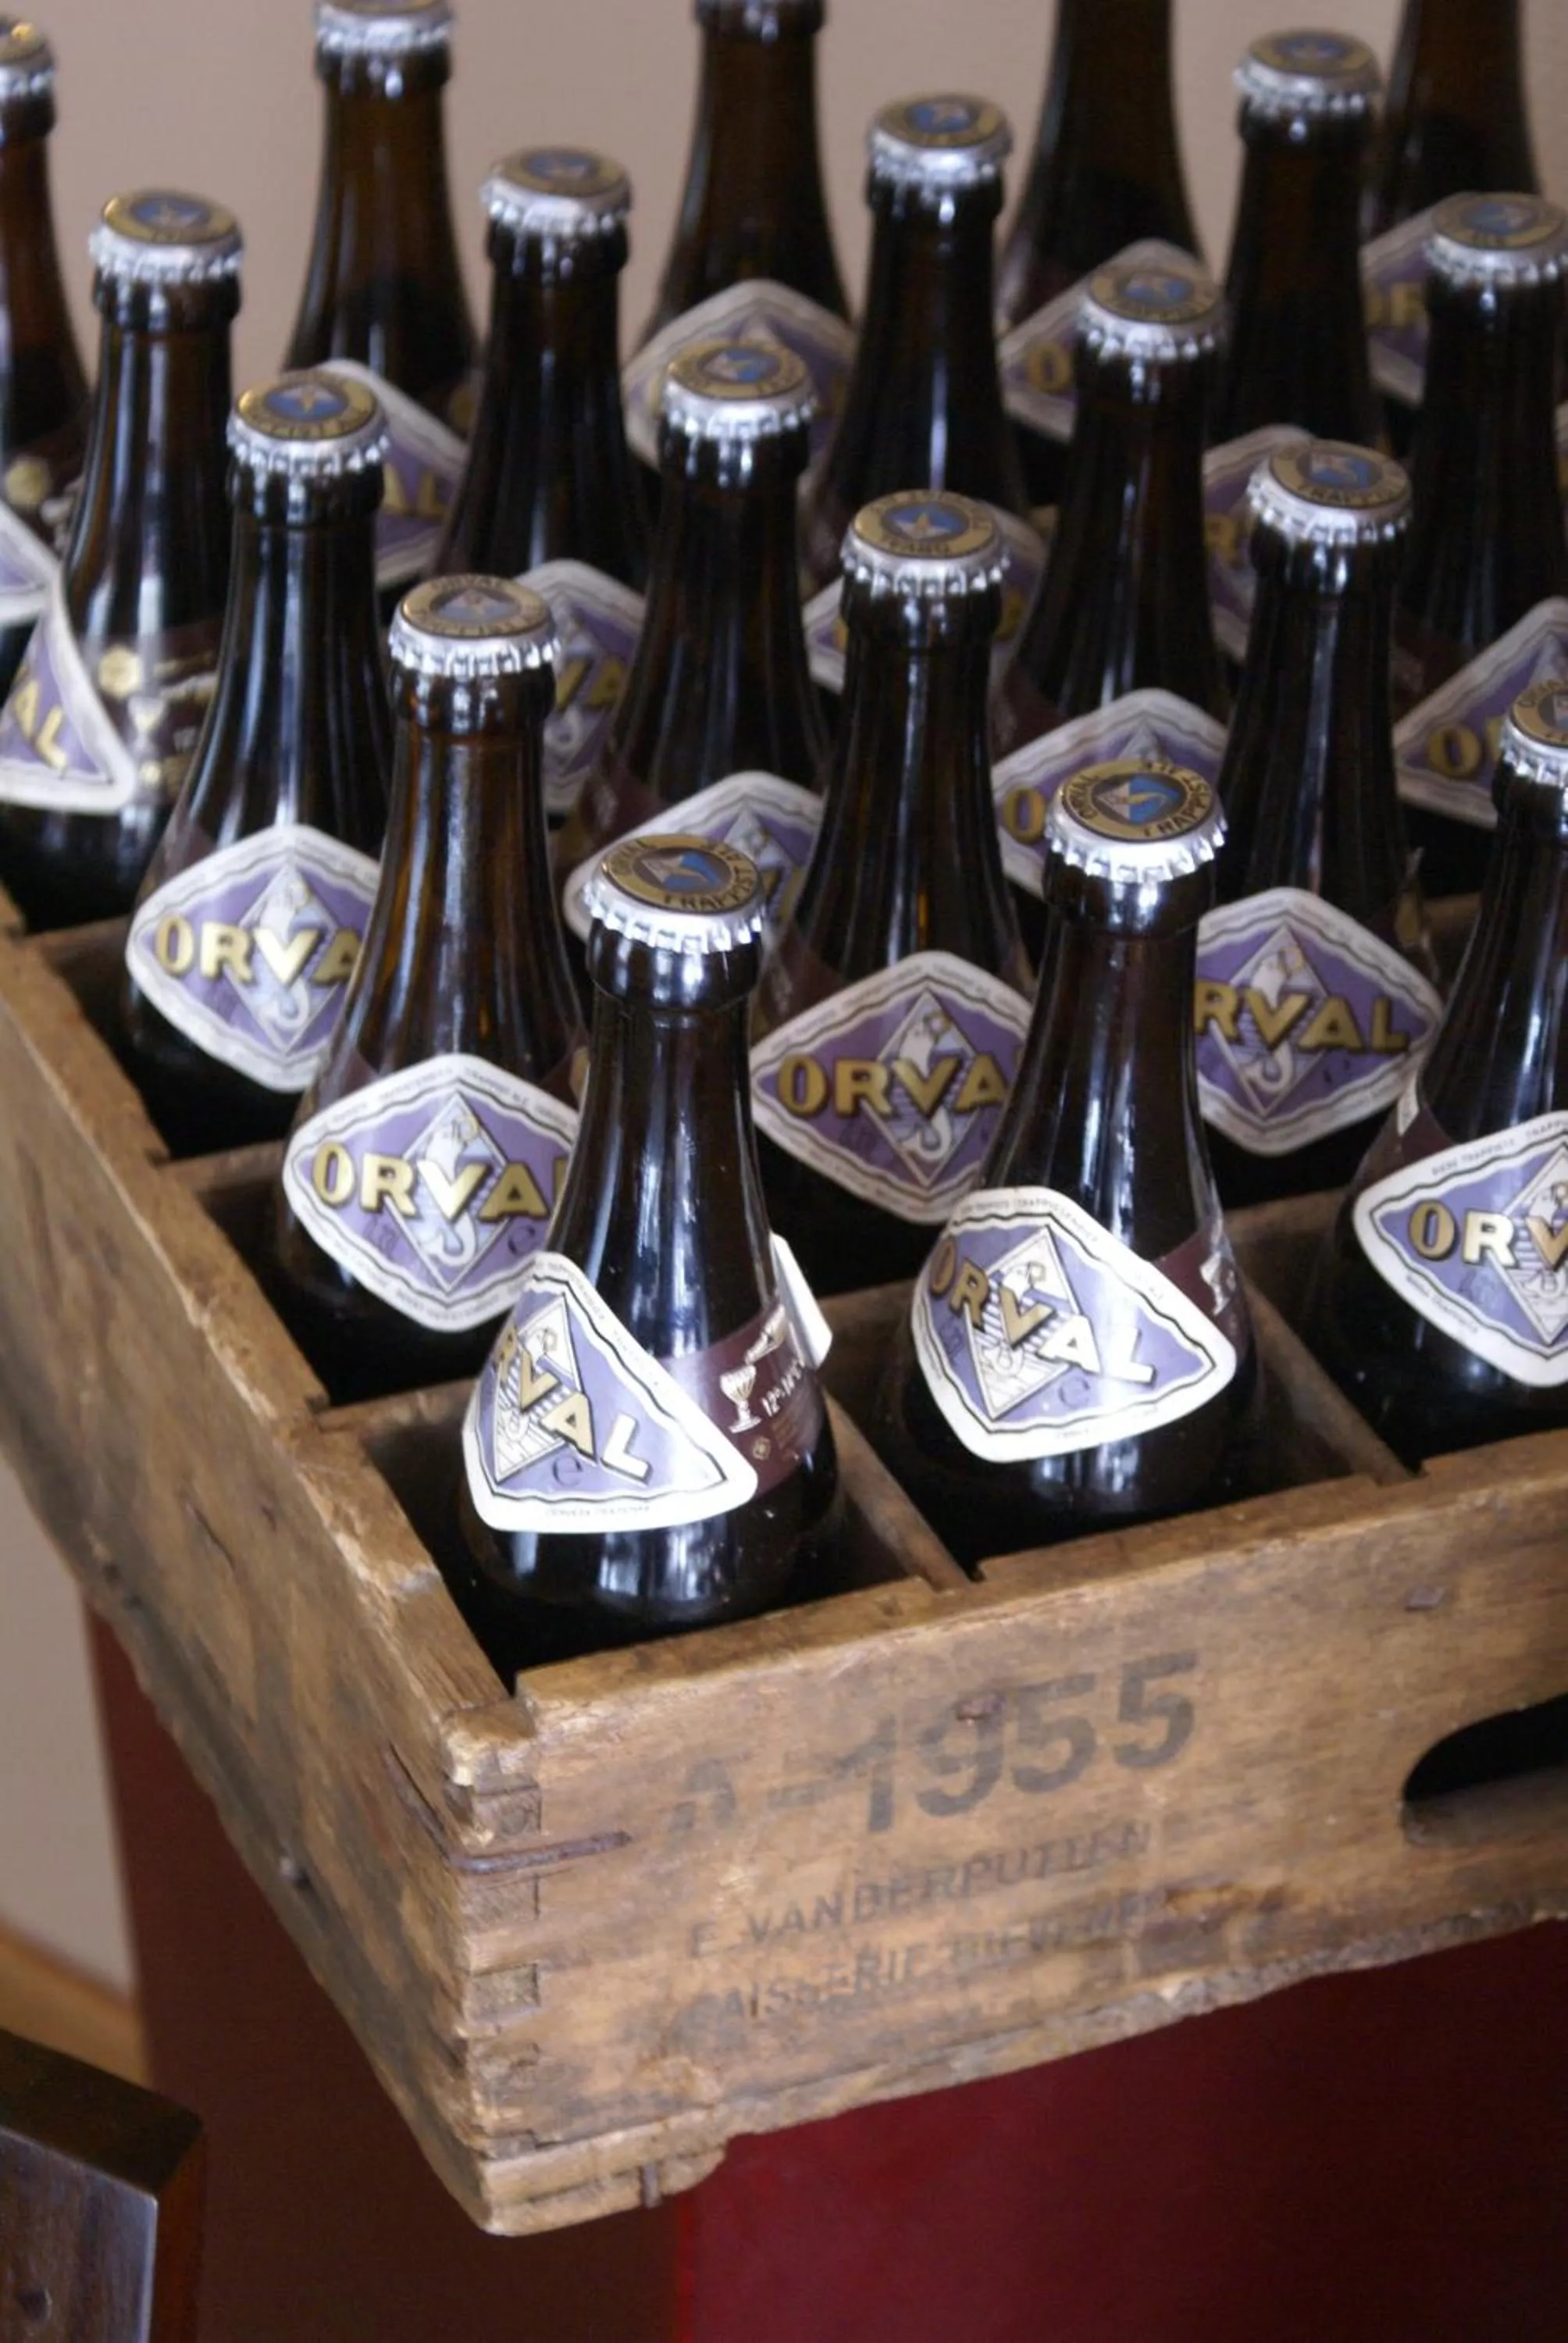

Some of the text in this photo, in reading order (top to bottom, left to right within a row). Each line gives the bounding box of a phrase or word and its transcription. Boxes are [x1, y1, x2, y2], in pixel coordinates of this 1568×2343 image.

[155, 913, 364, 986] ORVA
[1195, 979, 1409, 1052] RVAL
[777, 1054, 1007, 1117] ORVA
[927, 1238, 1158, 1385] ORVAL
